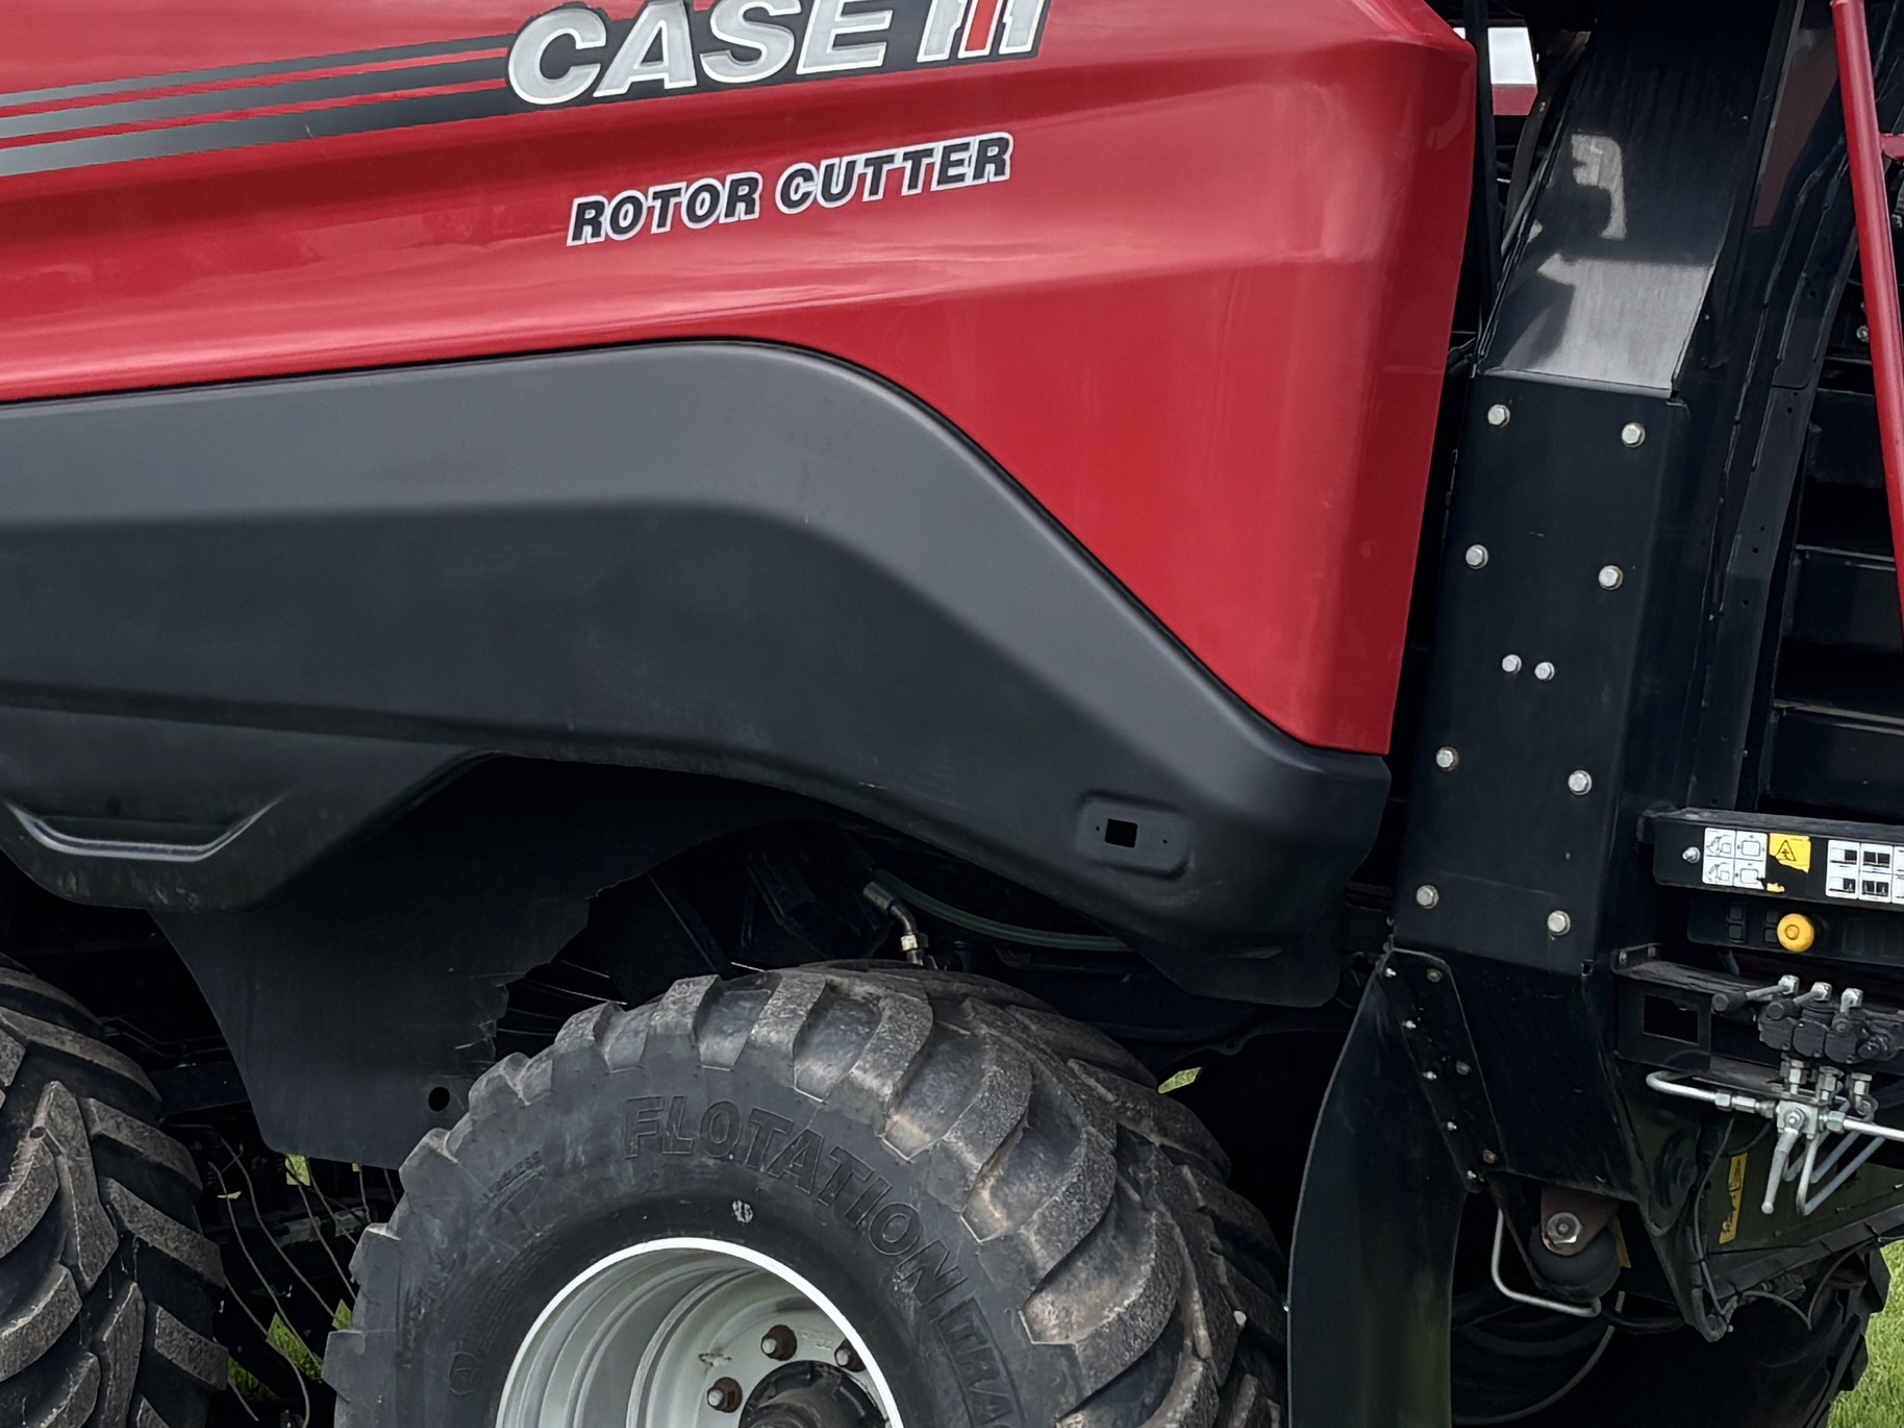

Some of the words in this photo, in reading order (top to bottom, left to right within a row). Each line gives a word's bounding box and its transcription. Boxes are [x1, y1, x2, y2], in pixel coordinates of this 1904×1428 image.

[566, 171, 764, 248] ROTOR
[775, 132, 1015, 215] CUTTER
[624, 1095, 967, 1309] FLOTATION
